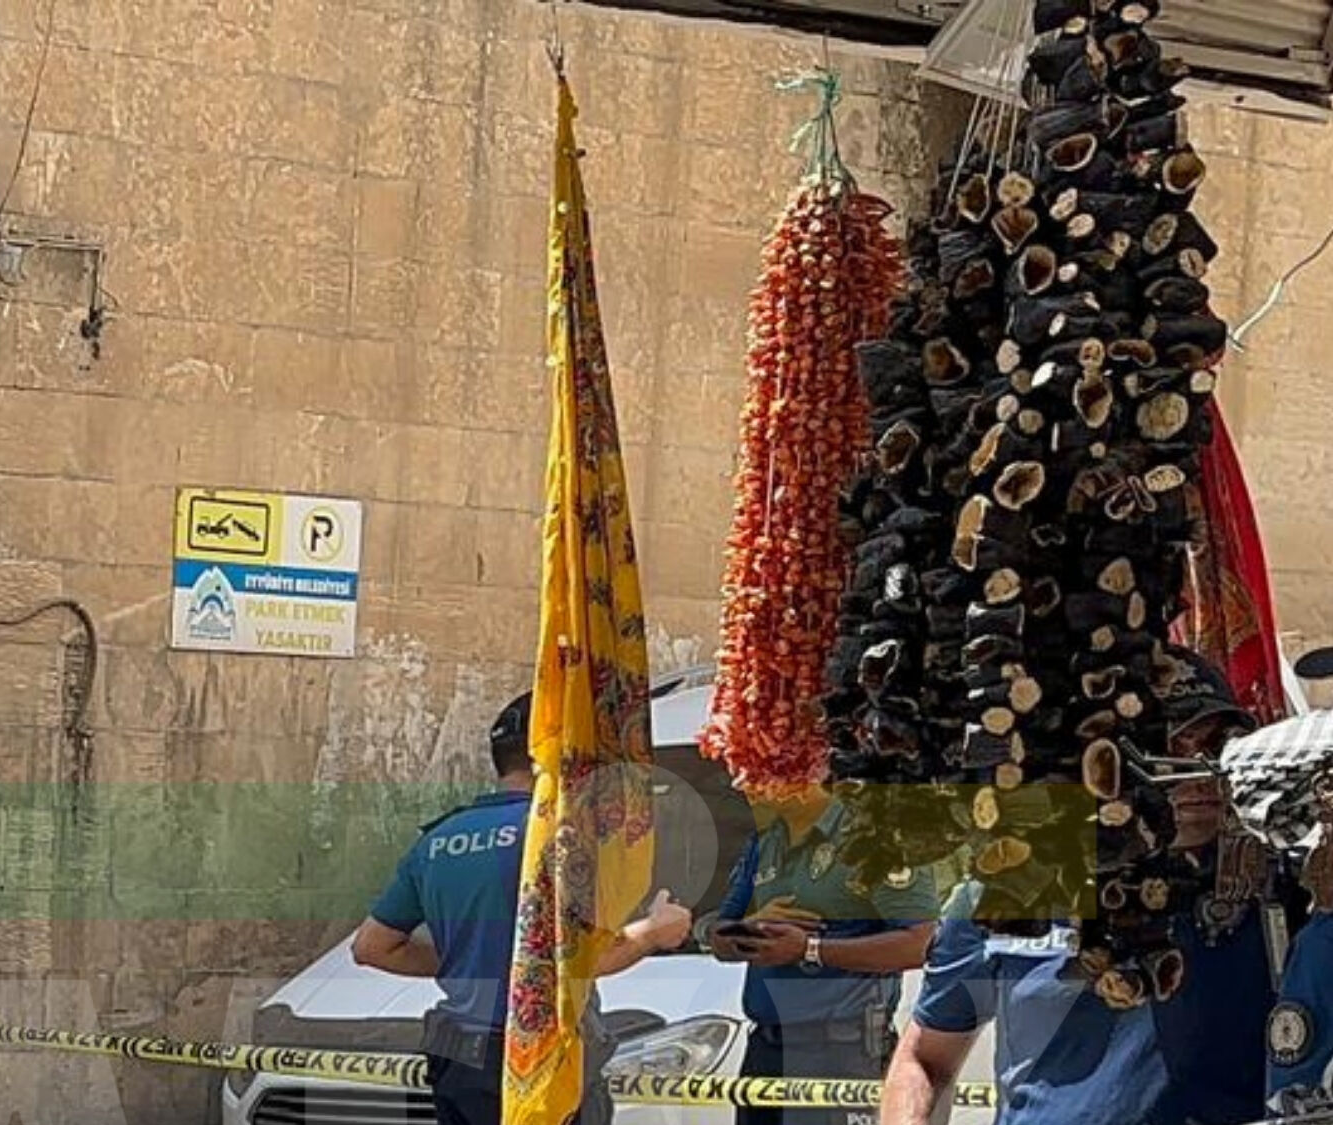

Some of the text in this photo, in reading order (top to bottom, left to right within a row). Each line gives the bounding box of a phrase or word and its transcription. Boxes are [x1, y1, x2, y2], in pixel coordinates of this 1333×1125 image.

[246, 601, 345, 624] PARK ETMEK
[255, 627, 333, 650] YASAKTIR
